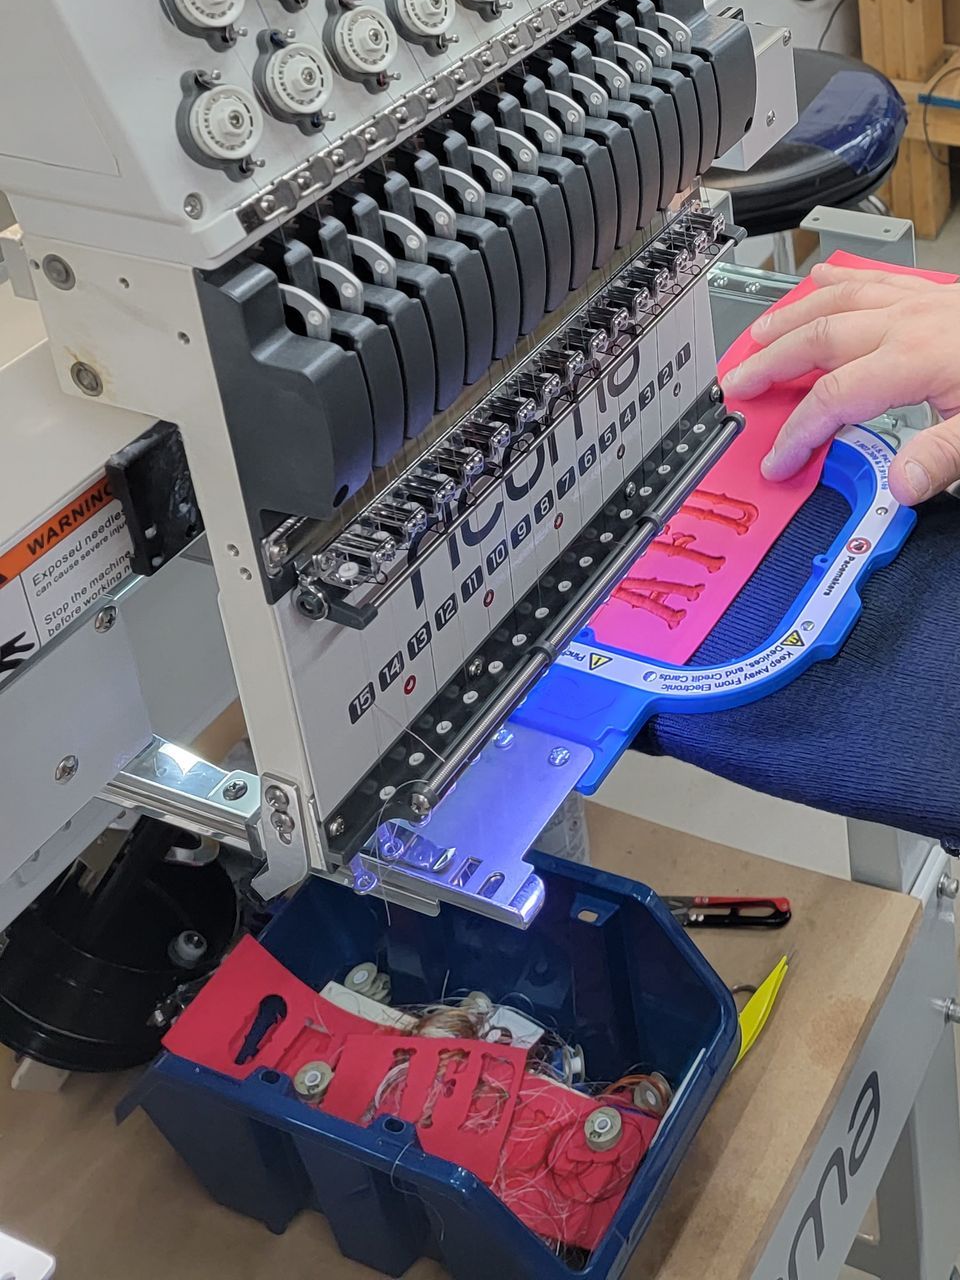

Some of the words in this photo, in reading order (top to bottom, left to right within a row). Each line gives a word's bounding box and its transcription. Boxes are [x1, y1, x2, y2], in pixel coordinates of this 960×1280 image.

[32, 539, 83, 587] Exposed
[35, 581, 52, 597] can
[53, 559, 80, 583] cause
[80, 535, 109, 561] severe
[822, 556, 856, 597] Pacemakers
[44, 600, 69, 626] Stop
[71, 585, 88, 604] the
[89, 549, 131, 589] machine
[47, 606, 82, 637] before
[82, 572, 122, 606] working
[739, 644, 785, 673] Devices,
[769, 651, 794, 668] Keep
[659, 673, 689, 683] Cards
[691, 671, 723, 683] Credit
[723, 667, 740, 679] and
[744, 663, 770, 682] Away
[661, 683, 712, 693] Electronic
[715, 677, 742, 691] From
